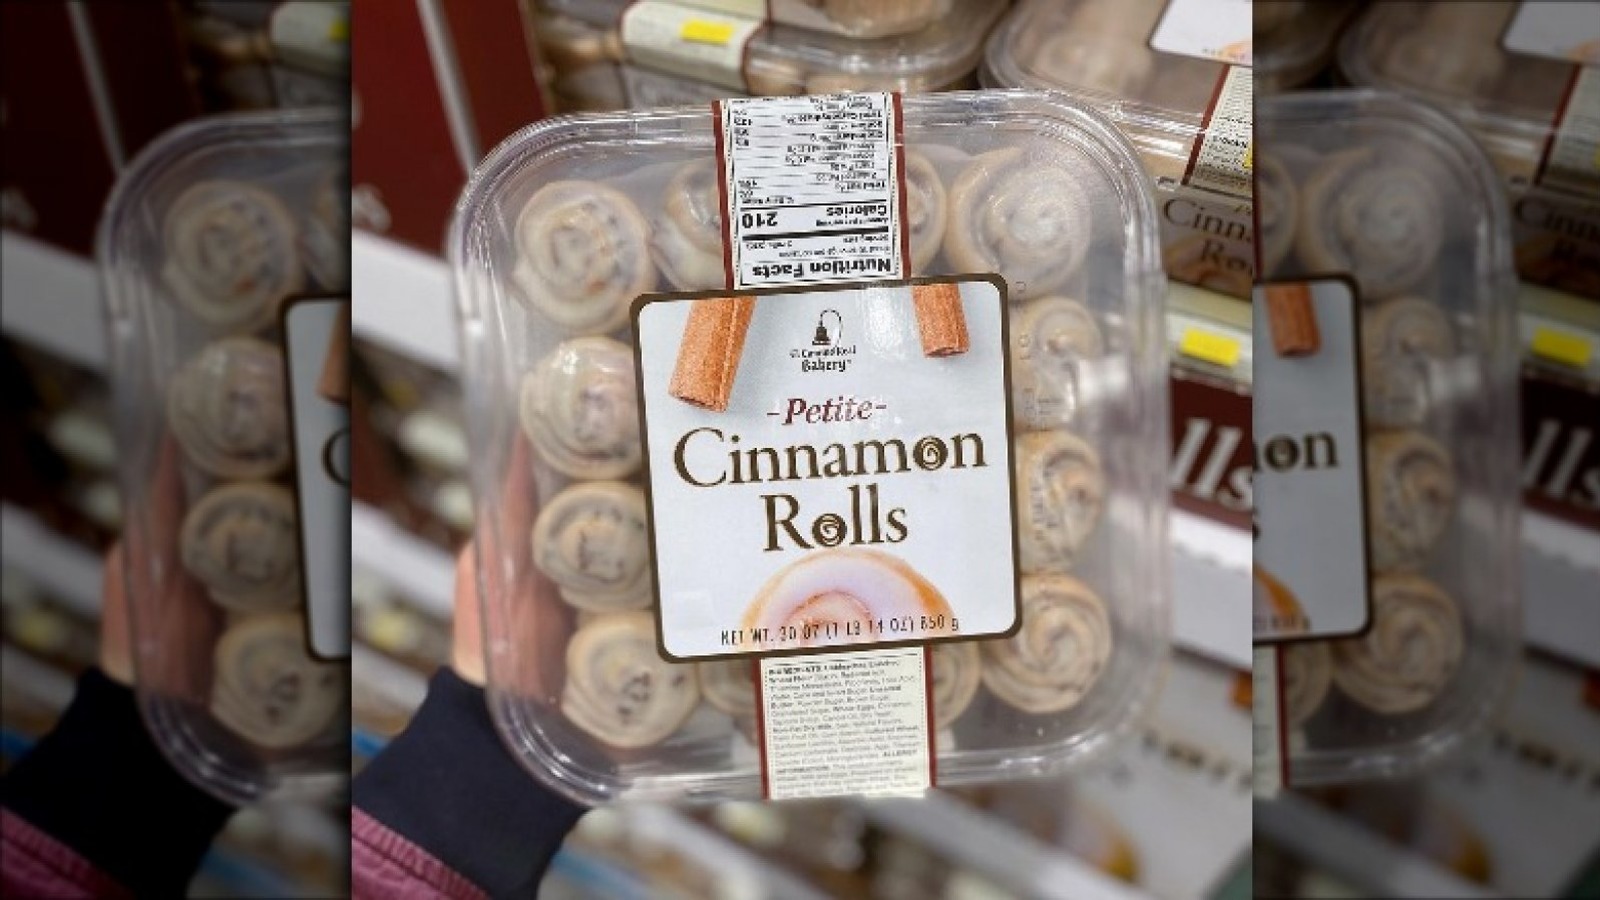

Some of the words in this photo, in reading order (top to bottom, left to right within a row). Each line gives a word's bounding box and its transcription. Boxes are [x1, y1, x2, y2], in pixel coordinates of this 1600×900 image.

[742, 211, 778, 229] 210
[826, 205, 887, 218] Calories
[1163, 199, 1252, 242] Cinn
[752, 262, 805, 280] Facts
[809, 258, 891, 276] Nutrition
[673, 426, 988, 488] Cinnamon
[759, 482, 909, 553] Rolls
